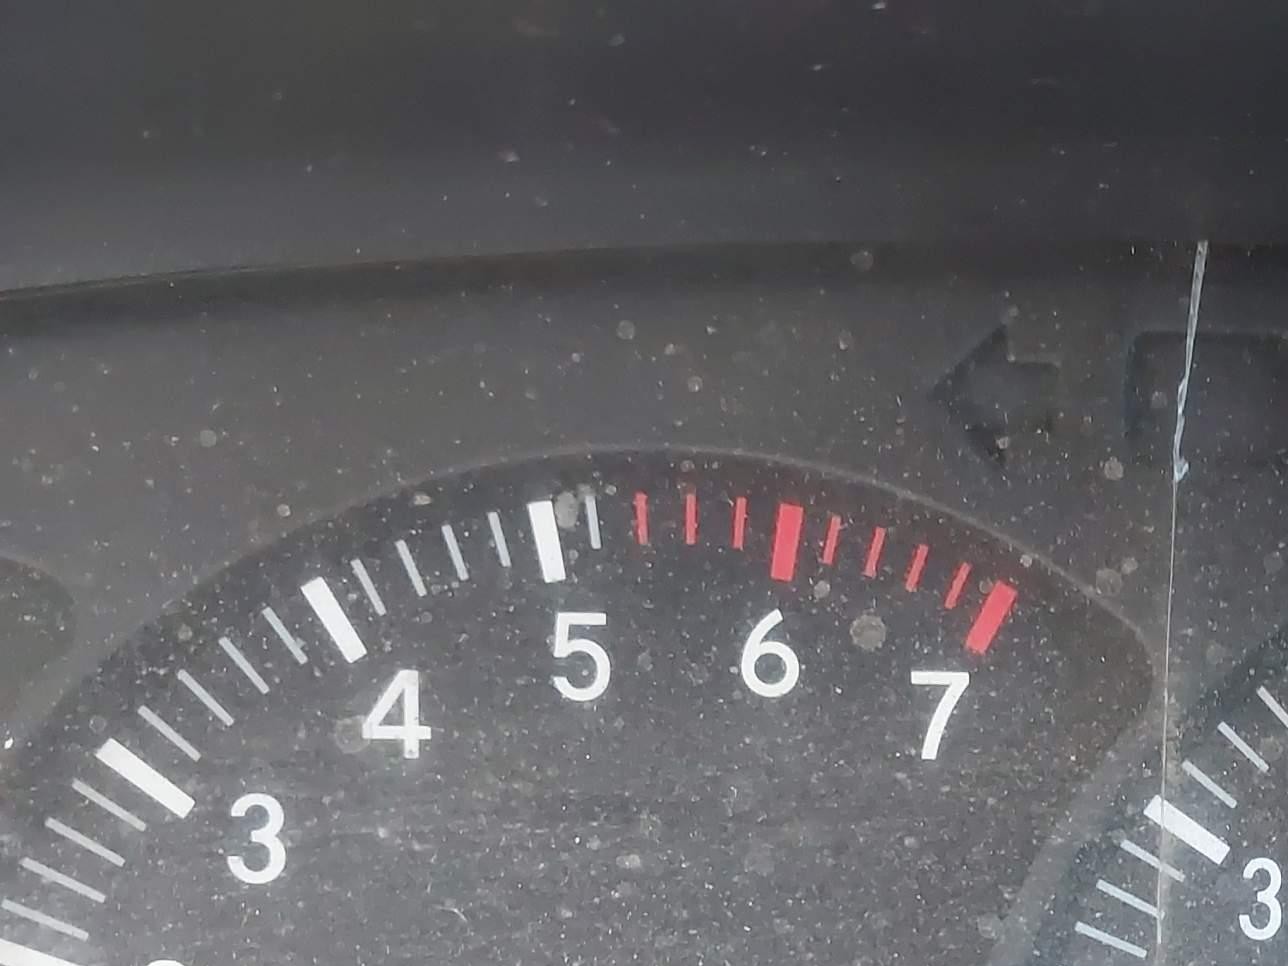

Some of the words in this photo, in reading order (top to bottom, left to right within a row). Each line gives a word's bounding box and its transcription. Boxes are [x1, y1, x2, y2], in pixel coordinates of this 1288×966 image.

[550, 612, 611, 702] 5
[740, 608, 802, 700] 6
[361, 669, 432, 758] 4
[910, 670, 970, 761] 7
[226, 792, 288, 886] 3
